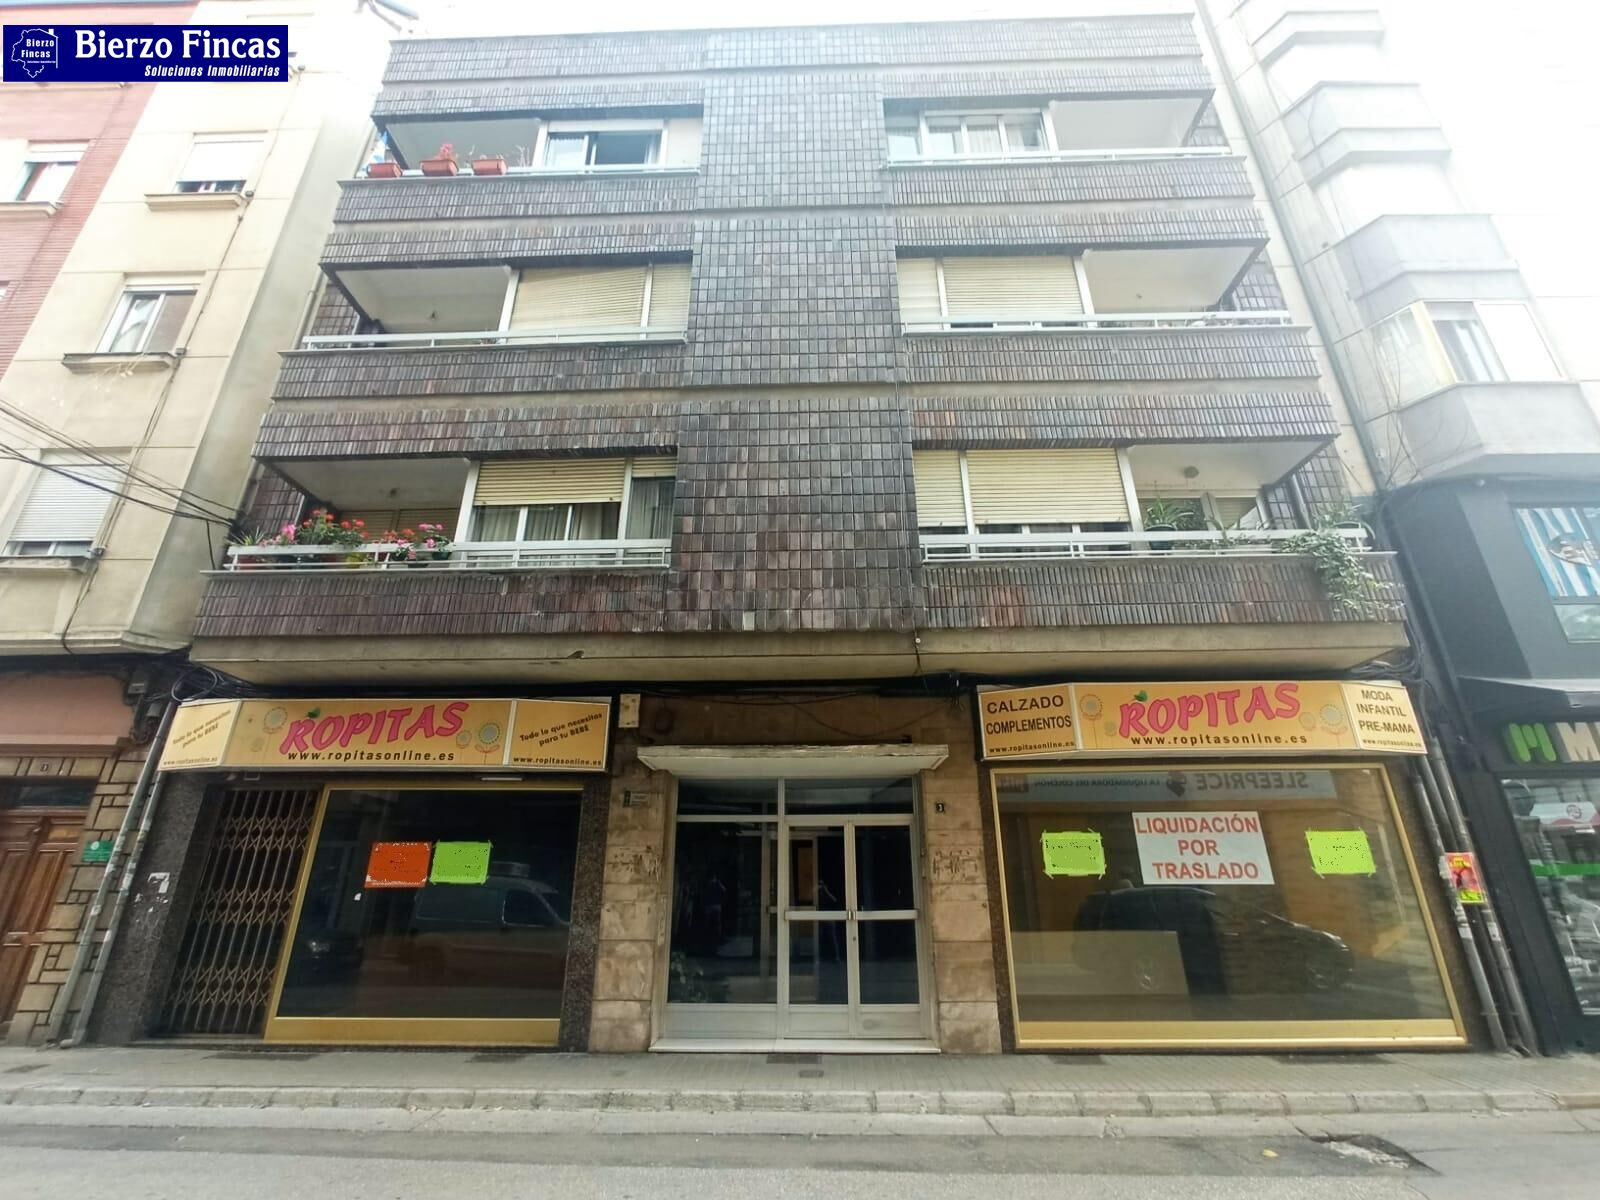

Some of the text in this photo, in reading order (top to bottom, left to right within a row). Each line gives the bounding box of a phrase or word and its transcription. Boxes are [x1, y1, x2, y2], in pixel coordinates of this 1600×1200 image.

[1361, 689, 1393, 701] MODA
[987, 695, 1064, 714] CALZADO
[1119, 682, 1301, 739] ROPITAS
[1356, 703, 1407, 717] INFANTIL
[279, 701, 470, 755] ROPITAS
[520, 731, 540, 742] Todo
[551, 724, 566, 733] que
[567, 712, 603, 728] necesitas
[985, 715, 1073, 735] COMPLEMENTOS
[1359, 719, 1416, 734] PRE-MAMA
[539, 734, 558, 747] para
[560, 731, 568, 739] tu
[989, 741, 1075, 753] www.ropitasonline.es
[1131, 733, 1308, 746] www.ropitasonline.es
[288, 750, 455, 762] www.ropitasonline.es
[1135, 813, 1260, 834] LIQUIDACIÓN
[1178, 839, 1220, 856] POR
[1152, 862, 1260, 879] TRASLADO
